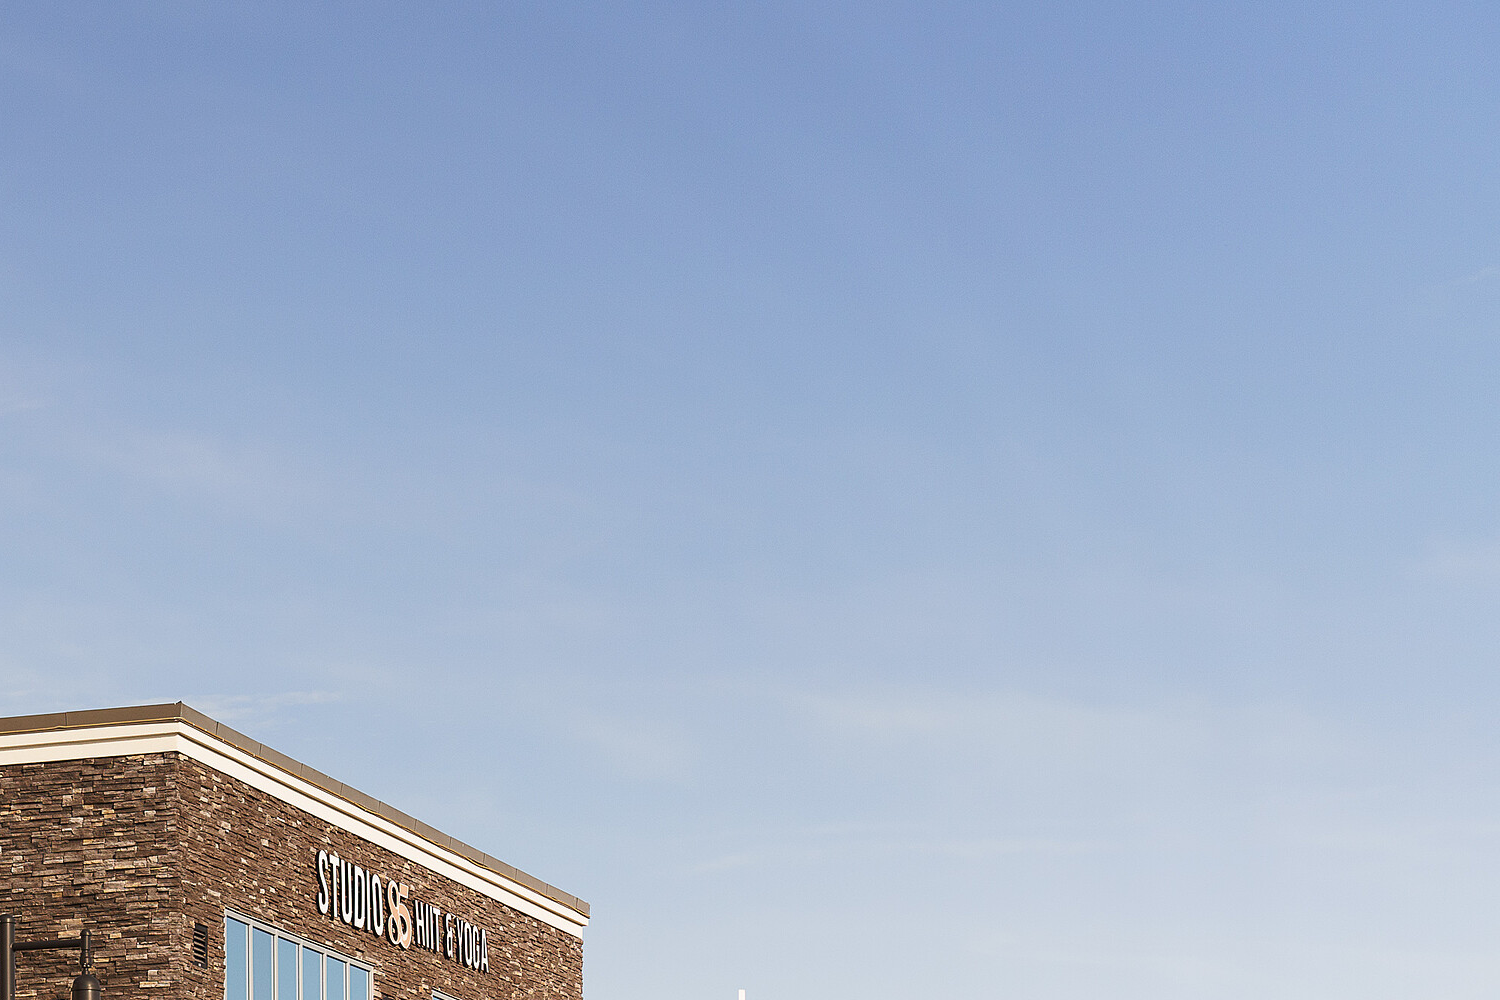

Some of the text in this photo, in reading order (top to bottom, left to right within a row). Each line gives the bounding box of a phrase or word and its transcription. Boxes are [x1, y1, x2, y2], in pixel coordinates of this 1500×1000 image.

[318, 850, 490, 973] STUDIO 85 HIIT & YOGA
